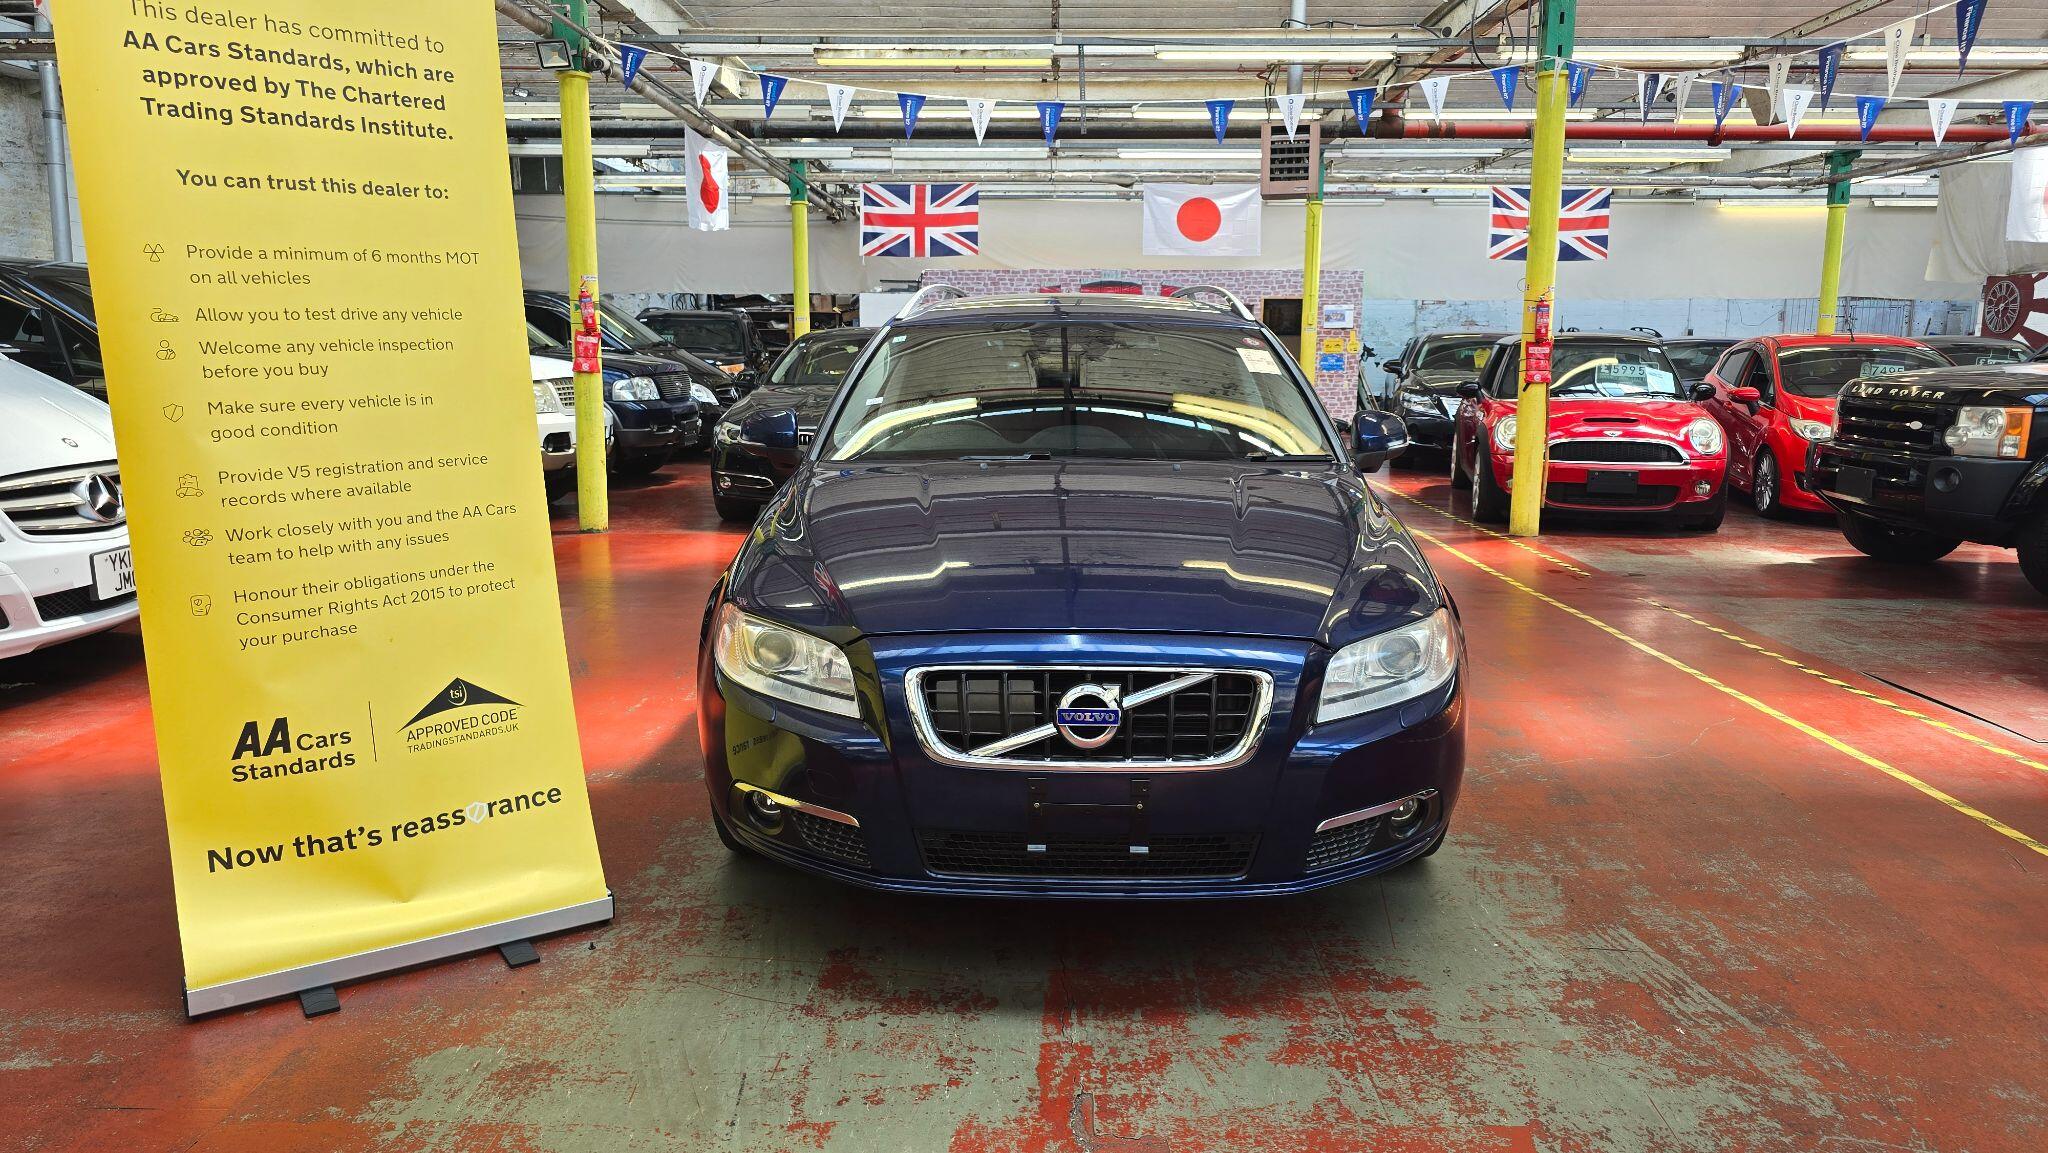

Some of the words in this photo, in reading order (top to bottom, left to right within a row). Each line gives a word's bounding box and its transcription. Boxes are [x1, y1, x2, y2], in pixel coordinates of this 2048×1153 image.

[132, 0, 177, 21] This
[185, 5, 258, 30] dealer
[264, 13, 302, 36] has
[308, 25, 419, 51] committed
[424, 35, 444, 54] to
[1969, 5, 1978, 31] Found
[123, 30, 160, 52] AA
[165, 34, 221, 58] Cars
[227, 41, 351, 75] Standards,
[355, 58, 418, 80] which
[423, 68, 455, 83] are
[142, 69, 258, 93] approved
[263, 76, 291, 99] by
[294, 79, 336, 101] The
[342, 85, 446, 111] Chartered
[139, 96, 234, 126] Trading
[240, 105, 356, 132] Standards
[360, 116, 454, 140] Institute.
[175, 168, 218, 187] You
[223, 176, 262, 189] can
[266, 174, 317, 192] trust
[320, 177, 357, 195] this
[362, 180, 420, 198] dealer
[424, 184, 449, 200] to:
[186, 244, 253, 260] Provide
[257, 250, 268, 260] a
[273, 246, 349, 261] minimum
[353, 248, 368, 262] of
[371, 249, 382, 263] 6
[386, 250, 442, 264] months
[445, 251, 480, 265] MOT
[189, 273, 212, 284] on
[217, 270, 238, 284] all
[240, 270, 311, 285] vehicles
[195, 306, 244, 322] Allow
[247, 311, 279, 324] you
[282, 307, 301, 321] to
[304, 307, 336, 321] test
[340, 307, 378, 321] drive
[382, 310, 408, 324] any
[410, 307, 463, 321] vehicle
[198, 340, 282, 355] Welcome
[286, 342, 315, 356] any
[319, 338, 374, 352] vehicle
[378, 338, 454, 354] inspection
[202, 364, 259, 379] before
[262, 366, 294, 380] you
[298, 362, 329, 378] buy
[207, 400, 254, 416] Make
[259, 401, 298, 413] sure
[300, 399, 345, 412] every
[348, 394, 401, 409] vehicle
[404, 393, 417, 406] is
[420, 393, 434, 406] in
[1851, 385, 1883, 395] LAND
[1889, 388, 1946, 400] ROVER
[210, 424, 255, 443] good
[260, 420, 338, 437] condition
[218, 467, 284, 485] Provide
[286, 464, 311, 479] V5
[315, 459, 404, 479] registration
[407, 456, 434, 470] and
[437, 453, 488, 468] service
[221, 490, 287, 508] records
[290, 487, 342, 502] where
[346, 480, 412, 497] available
[224, 525, 274, 544] Work
[277, 520, 334, 538] closely
[338, 516, 372, 532] with
[375, 516, 402, 531] you
[406, 510, 433, 525] and
[435, 508, 460, 522] the
[462, 505, 483, 518] AA
[485, 503, 517, 516] Cars
[227, 551, 272, 565] team
[276, 546, 294, 561] to
[298, 543, 334, 558] help
[337, 538, 372, 554] with
[375, 537, 402, 550] any
[405, 532, 450, 546] issues
[233, 586, 298, 604] Honour
[301, 580, 340, 596] their
[343, 571, 426, 591] obligations
[429, 564, 470, 579] under
[472, 560, 495, 573] the
[236, 606, 324, 626] Consumer
[328, 597, 379, 615] Rights
[382, 592, 407, 608] Act
[410, 586, 445, 604] 2015
[448, 585, 464, 598] to
[466, 577, 516, 598] protect
[239, 634, 280, 651] your
[282, 624, 358, 646] purchase
[449, 687, 463, 700] tsi
[406, 716, 480, 743] APPROVED
[481, 707, 519, 727] CODE
[1061, 712, 1115, 722] VOLVO
[232, 716, 291, 760] AA
[296, 729, 352, 751] Cars
[406, 722, 520, 754] TRADINGSTANDARDS.UK
[231, 749, 357, 783] Standards
[207, 842, 285, 874] Now
[292, 826, 383, 858] that's
